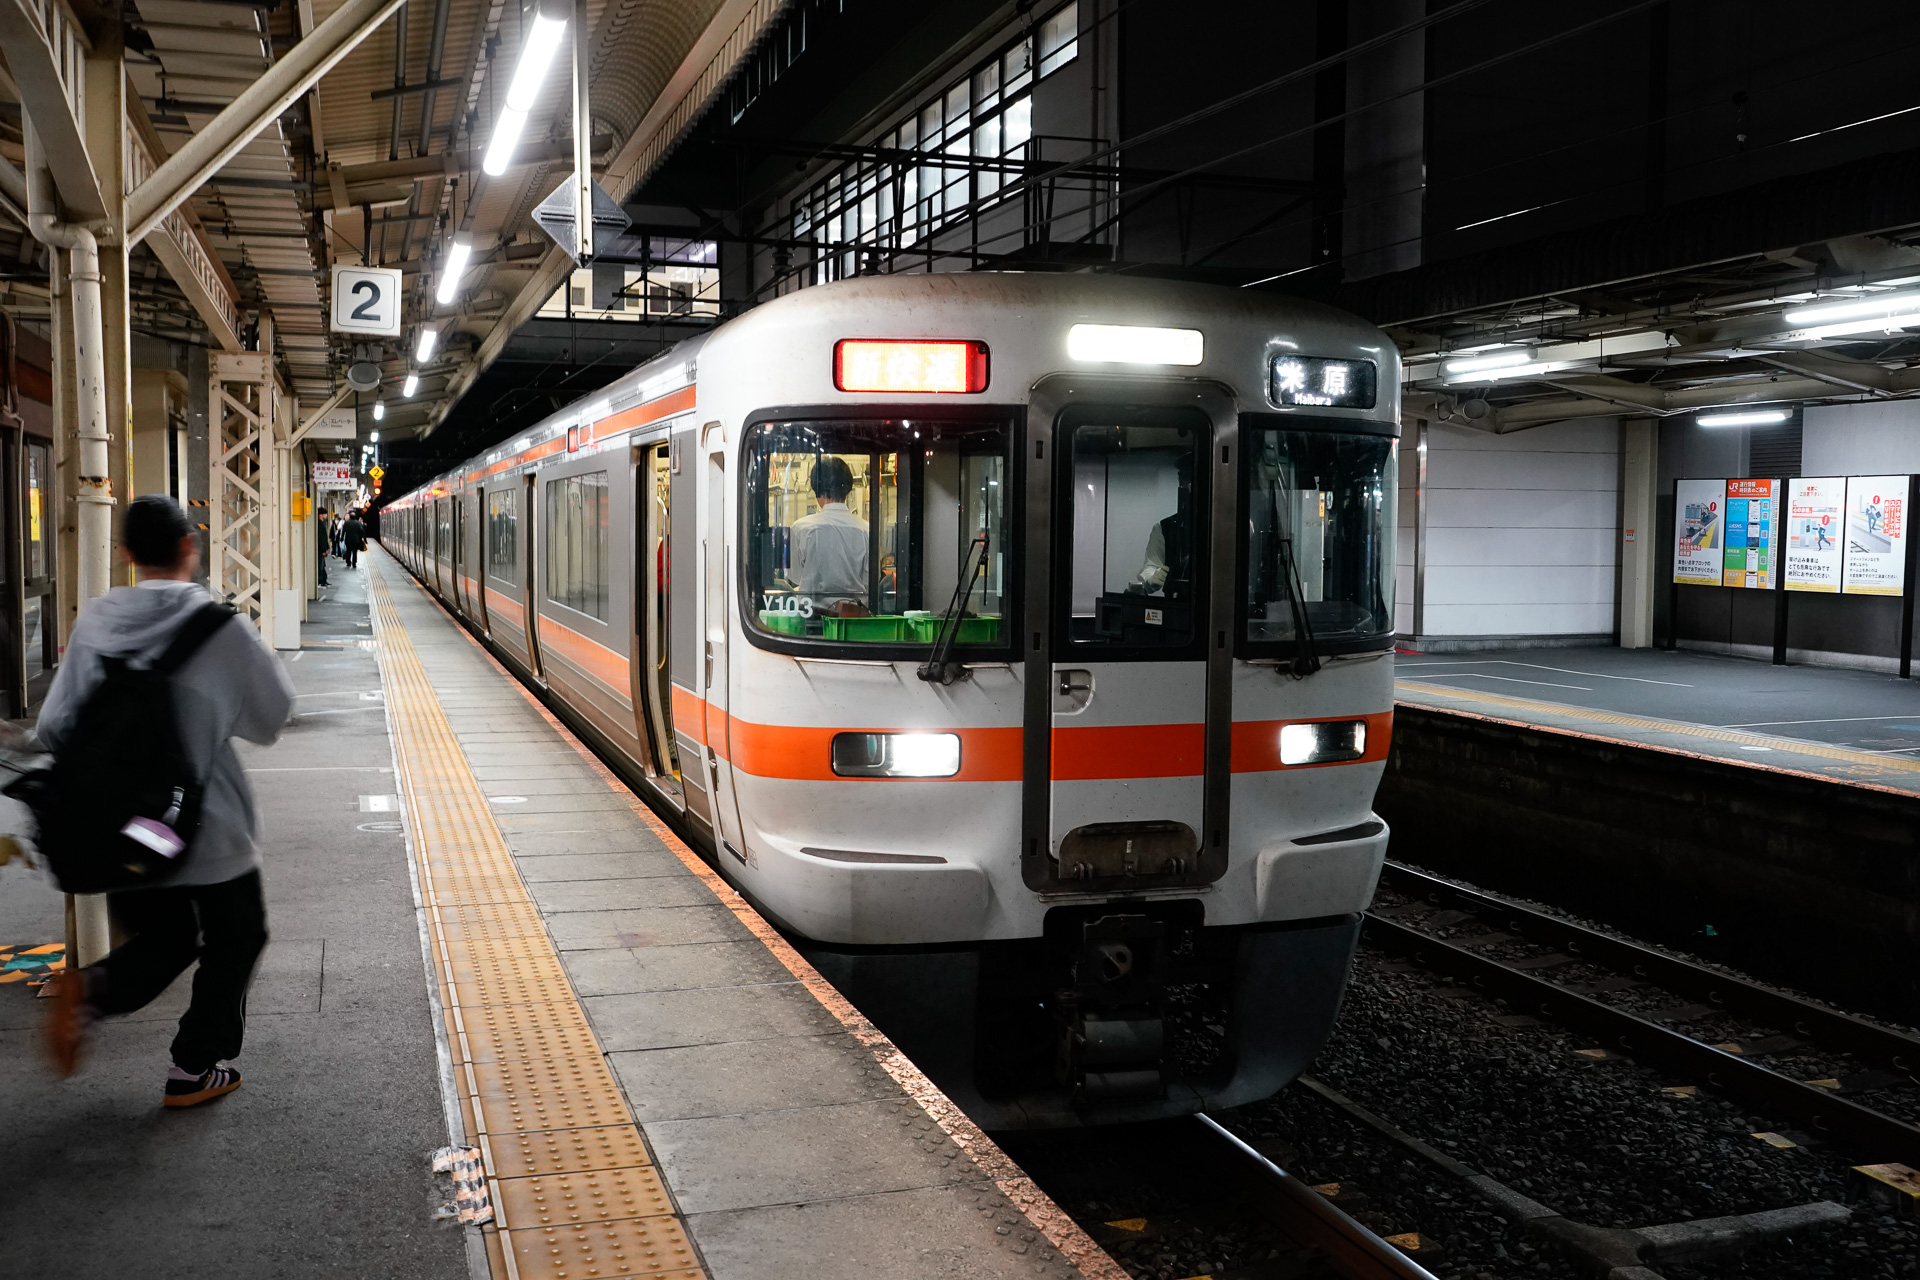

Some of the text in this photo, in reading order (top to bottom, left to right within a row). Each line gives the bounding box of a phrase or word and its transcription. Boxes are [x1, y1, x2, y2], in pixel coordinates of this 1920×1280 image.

[350, 280, 381, 321] 2
[1276, 362, 1348, 395] 米原
[1294, 393, 1331, 406] Maibara
[373, 468, 380, 477] 2
[762, 595, 813, 618] Y103
